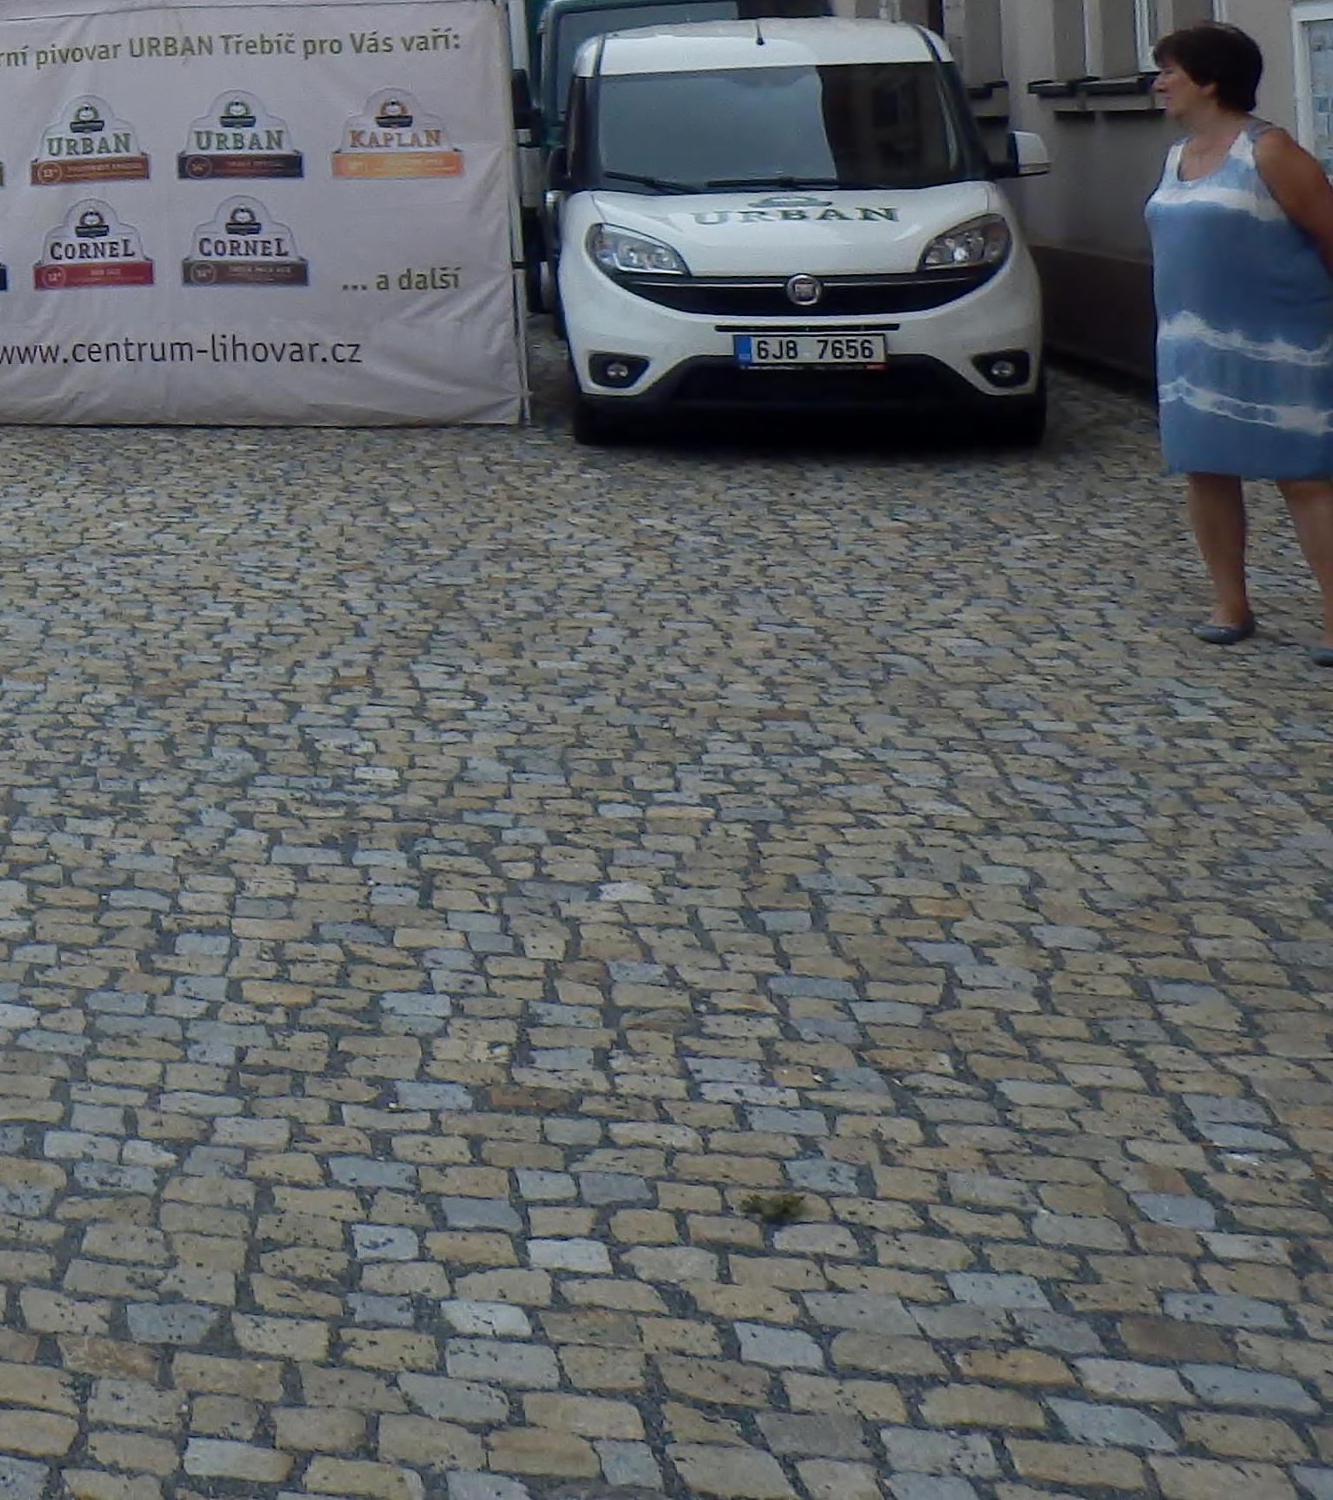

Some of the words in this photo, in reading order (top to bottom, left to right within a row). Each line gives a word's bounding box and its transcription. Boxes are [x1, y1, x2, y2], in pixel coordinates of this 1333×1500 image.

[35, 43, 122, 70] pivovar
[129, 35, 213, 57] URBAN
[220, 32, 297, 55] Třebíč
[303, 37, 342, 60] pro
[349, 30, 393, 52] Vás
[400, 28, 461, 52] vaří:
[46, 132, 132, 156] URBAN
[193, 129, 284, 150] URBAN
[349, 129, 442, 149] KAPLAN
[690, 206, 901, 225] URBAN
[50, 239, 136, 261] CORNEL
[198, 237, 290, 257] CORNEL
[376, 273, 390, 291] a
[398, 266, 462, 291] další
[816, 339, 875, 360] 7656
